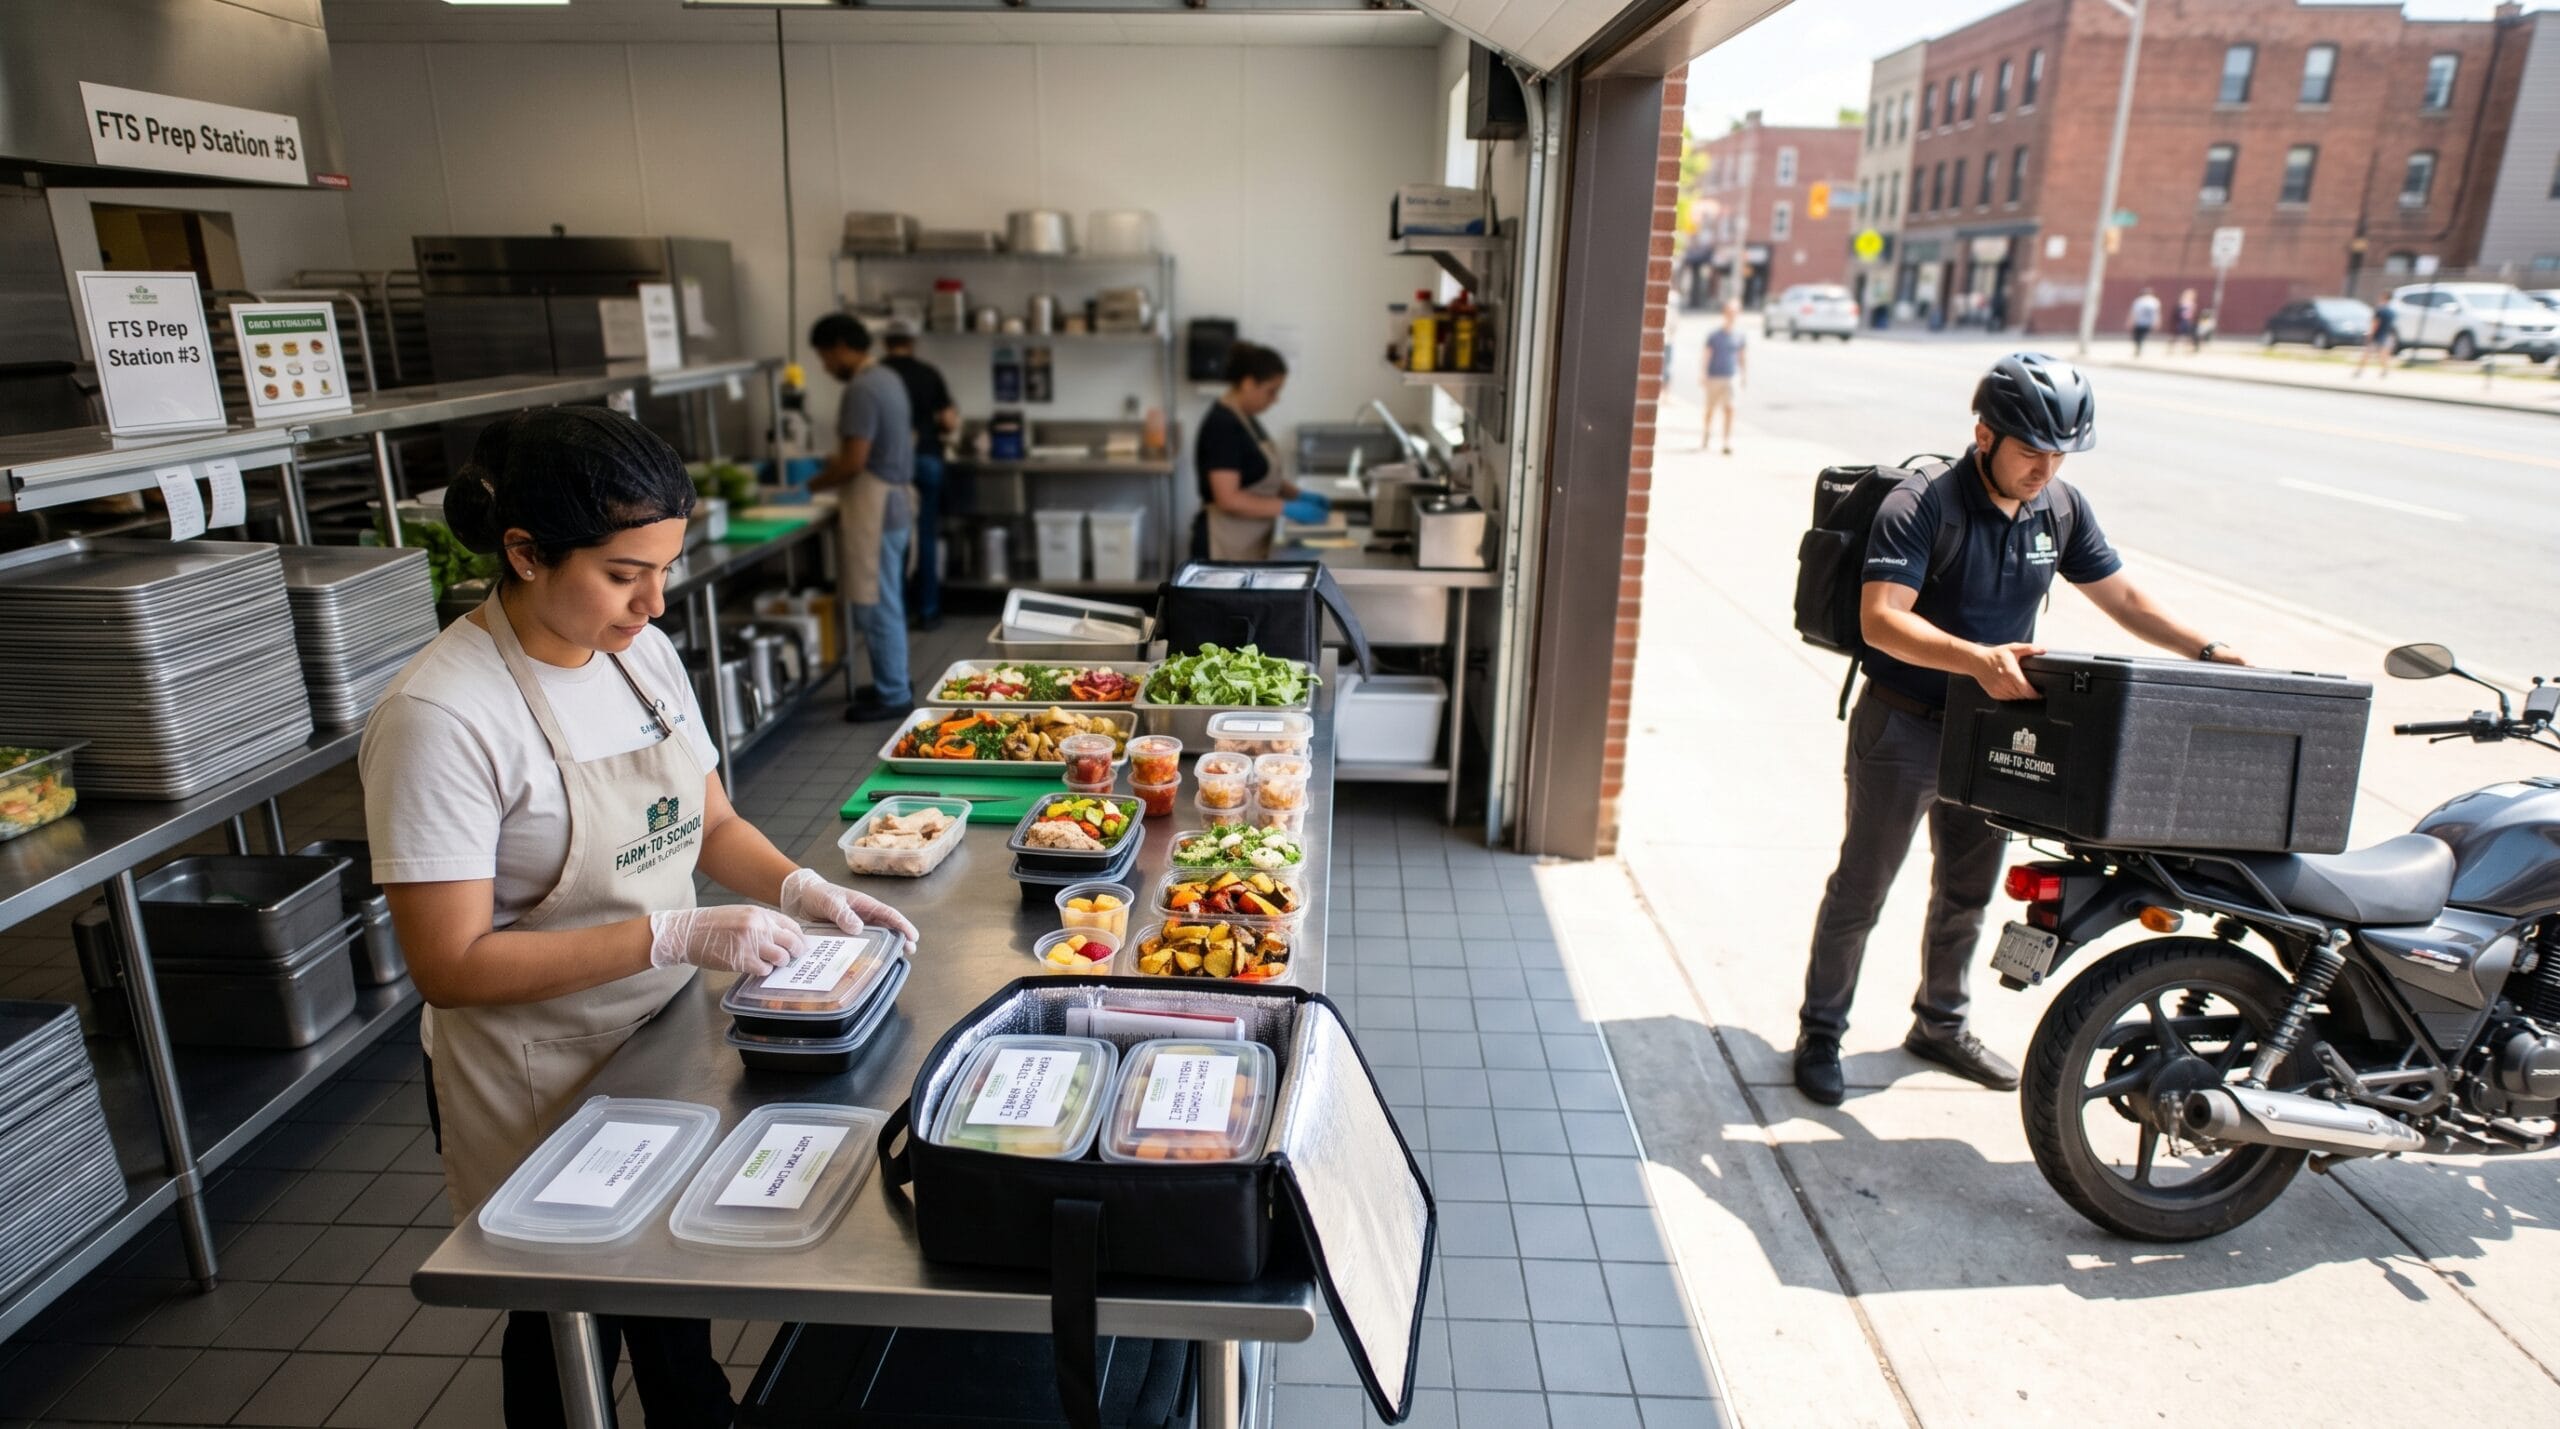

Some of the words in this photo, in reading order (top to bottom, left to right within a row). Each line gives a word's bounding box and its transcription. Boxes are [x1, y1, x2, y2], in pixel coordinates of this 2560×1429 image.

[96, 109, 140, 142] FTS
[146, 117, 196, 154] Prep
[200, 125, 270, 158] Station
[274, 135, 297, 161] #3
[108, 320, 143, 338] FTS
[147, 319, 188, 340] Prep
[108, 348, 175, 367] Station
[178, 345, 200, 363] #3
